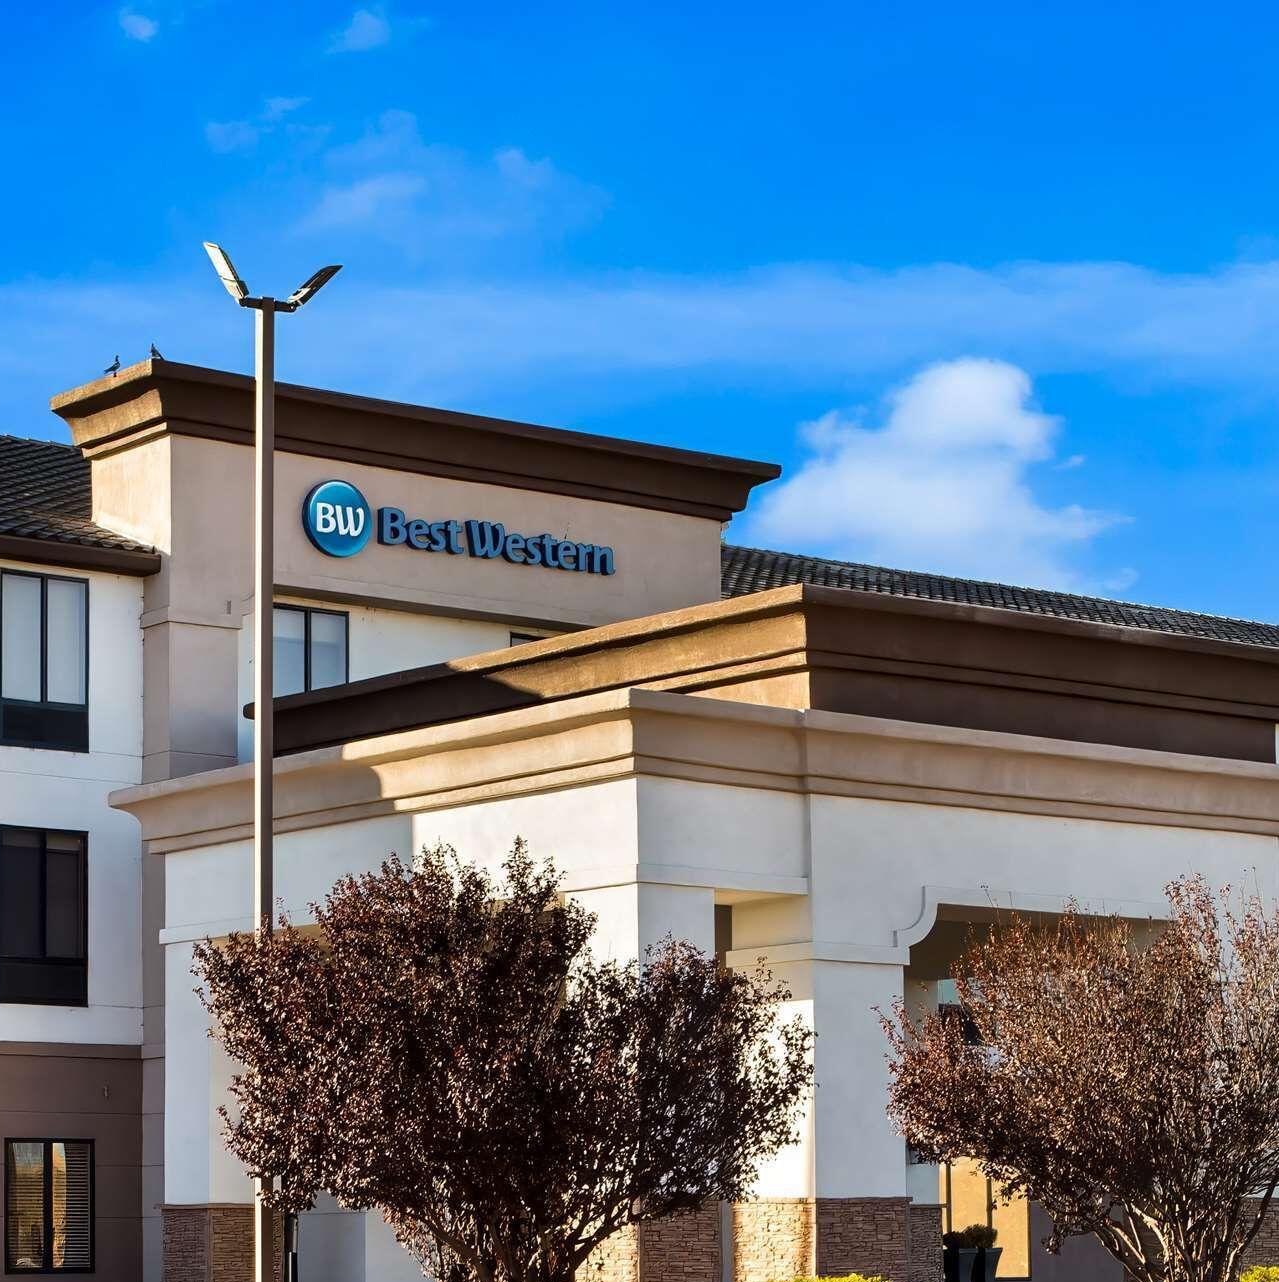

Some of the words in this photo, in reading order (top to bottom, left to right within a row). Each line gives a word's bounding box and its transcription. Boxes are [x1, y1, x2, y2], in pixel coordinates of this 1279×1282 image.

[316, 502, 365, 536] BW
[378, 507, 465, 555] Best
[466, 520, 615, 574] Western
